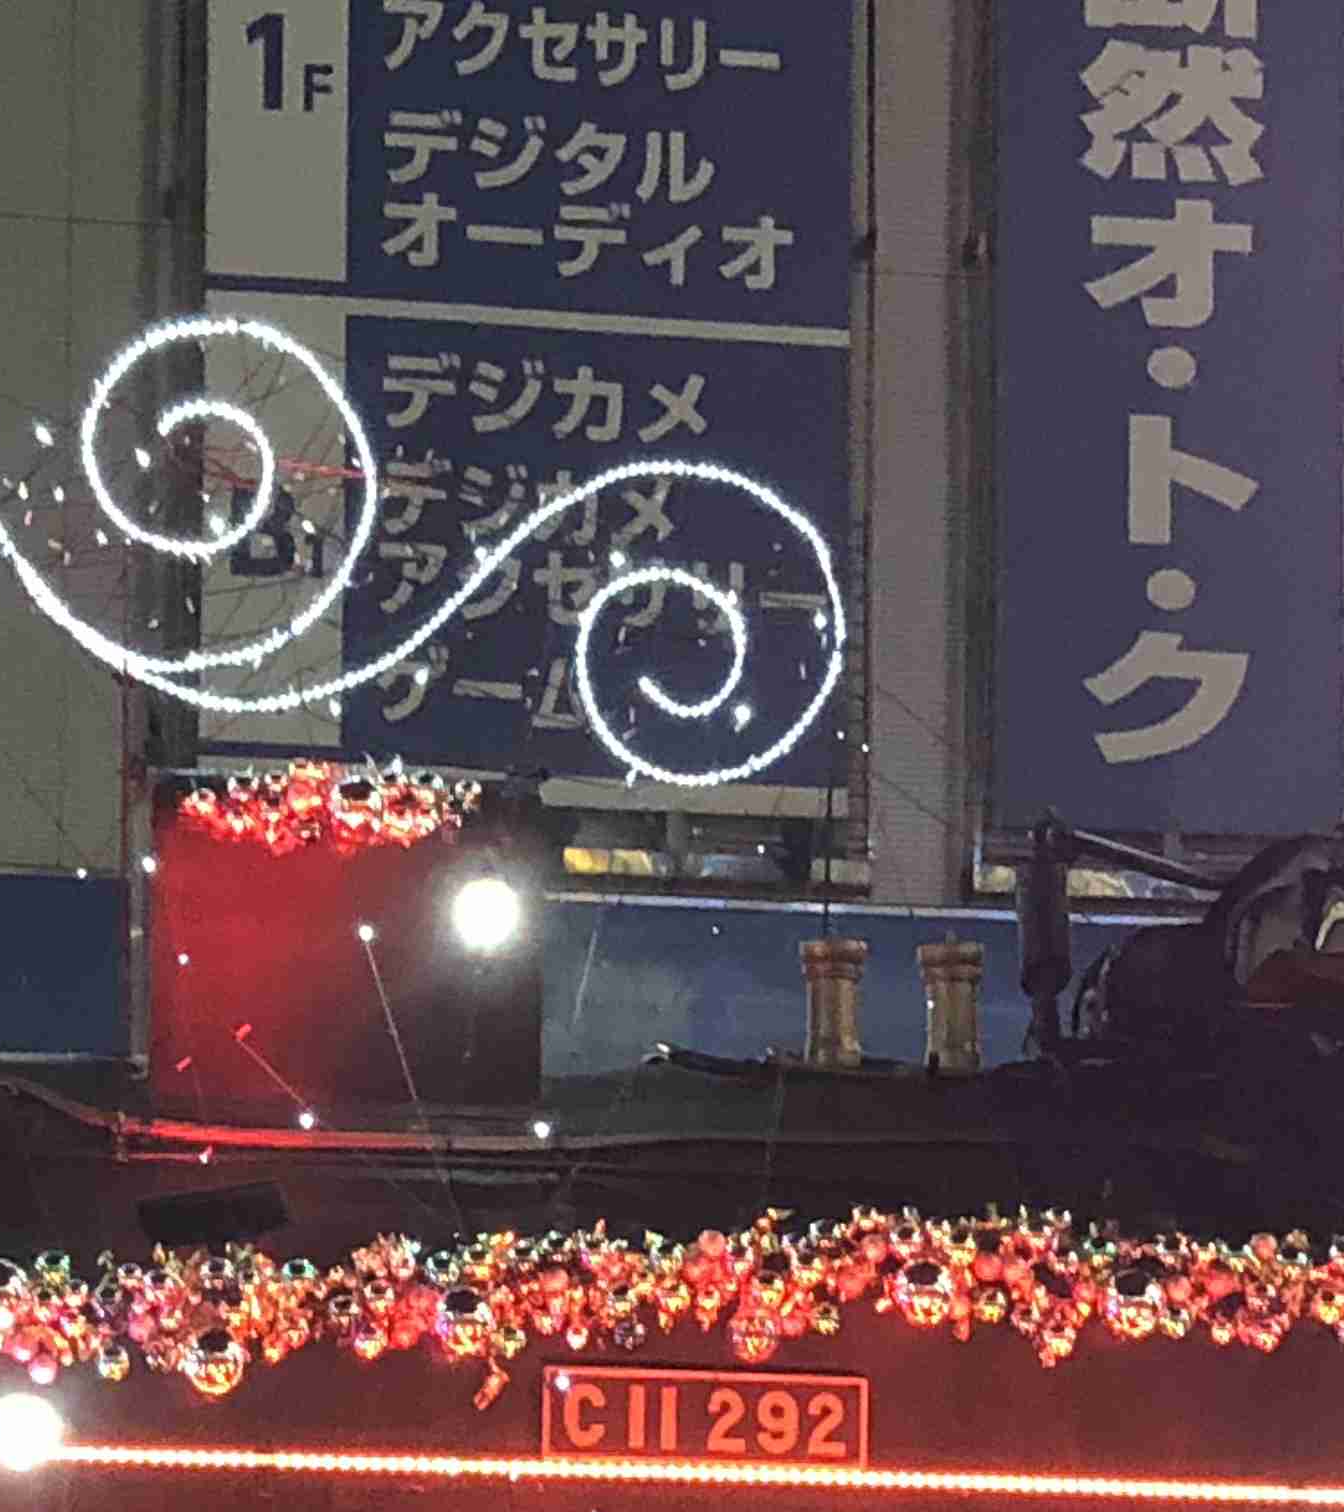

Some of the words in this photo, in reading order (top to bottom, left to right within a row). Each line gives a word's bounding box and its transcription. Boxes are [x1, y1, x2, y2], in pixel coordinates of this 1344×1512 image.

[382, 0, 782, 91] アクセサリー
[382, 109, 715, 203] デジタル
[382, 191, 794, 291] オーディオ
[382, 352, 708, 444] デジカメ
[1078, 0, 1266, 765] 然オ・ト・ク
[707, 1387, 847, 1458] 292
